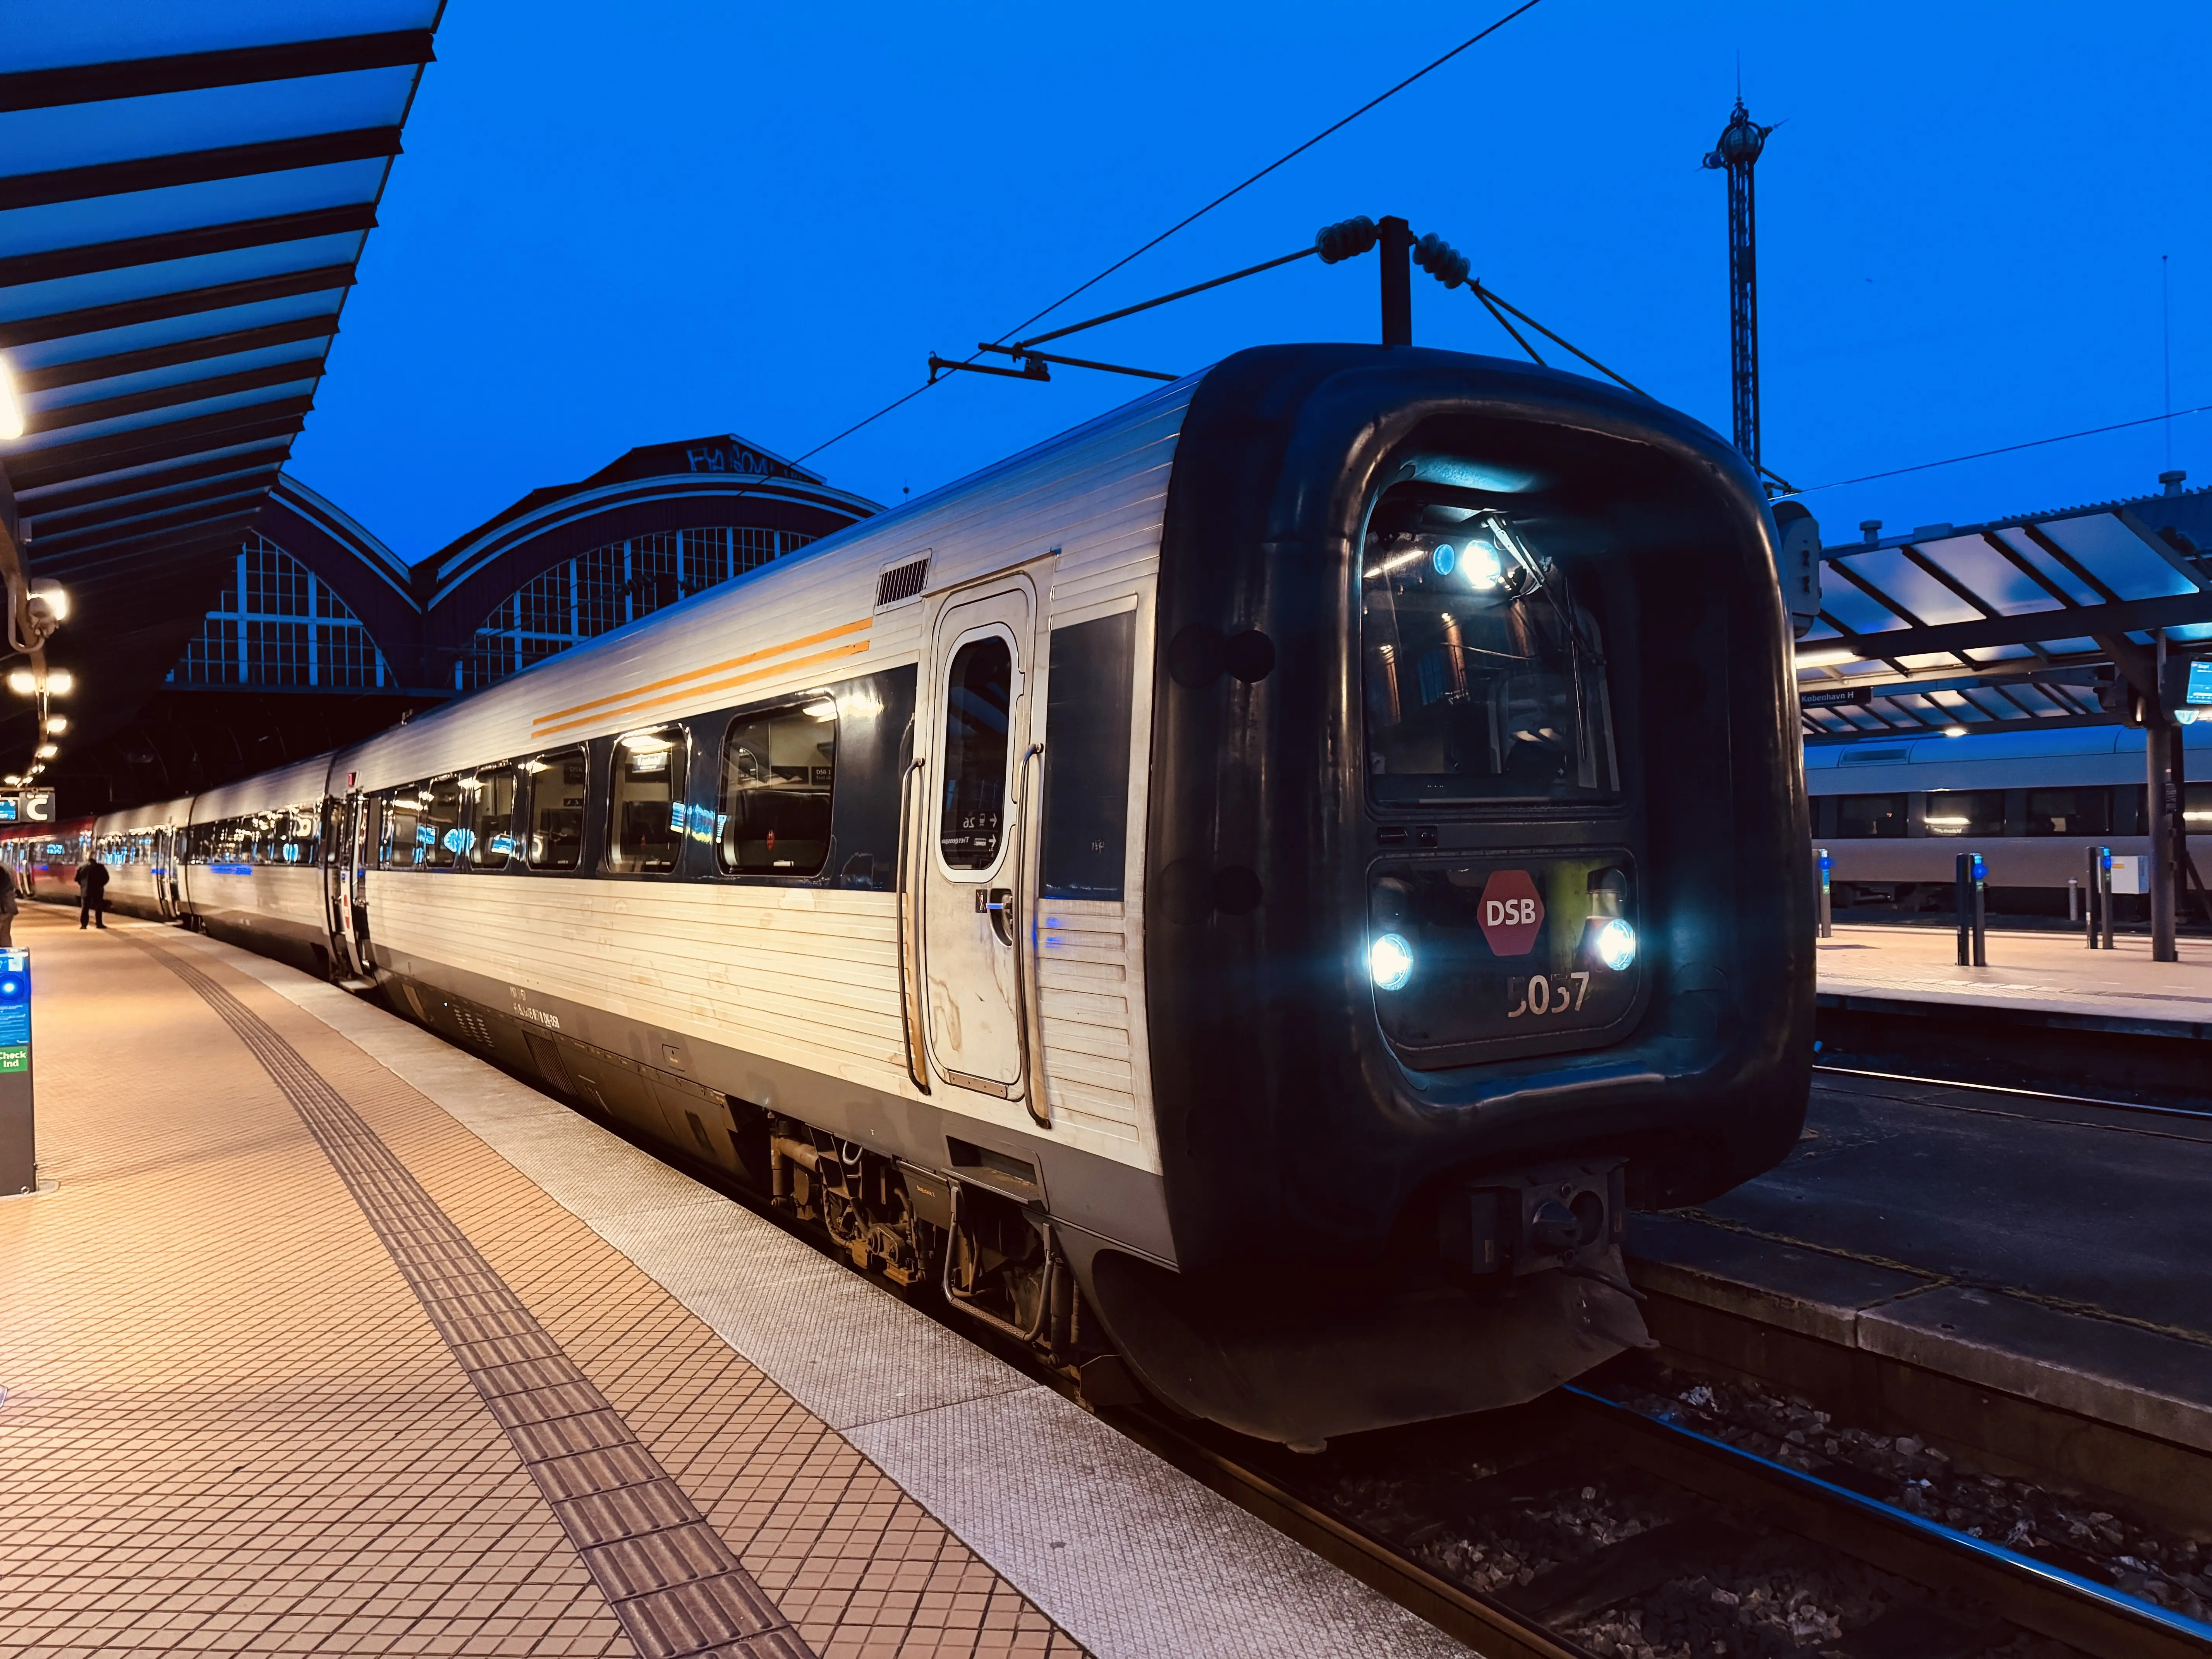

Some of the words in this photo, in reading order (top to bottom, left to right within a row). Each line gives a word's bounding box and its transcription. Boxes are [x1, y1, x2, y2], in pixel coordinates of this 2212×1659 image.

[1802, 694, 1845, 702] København
[27, 798, 48, 821] C
[1487, 899, 1535, 926] DSB
[3, 1059, 19, 1068] Ind
